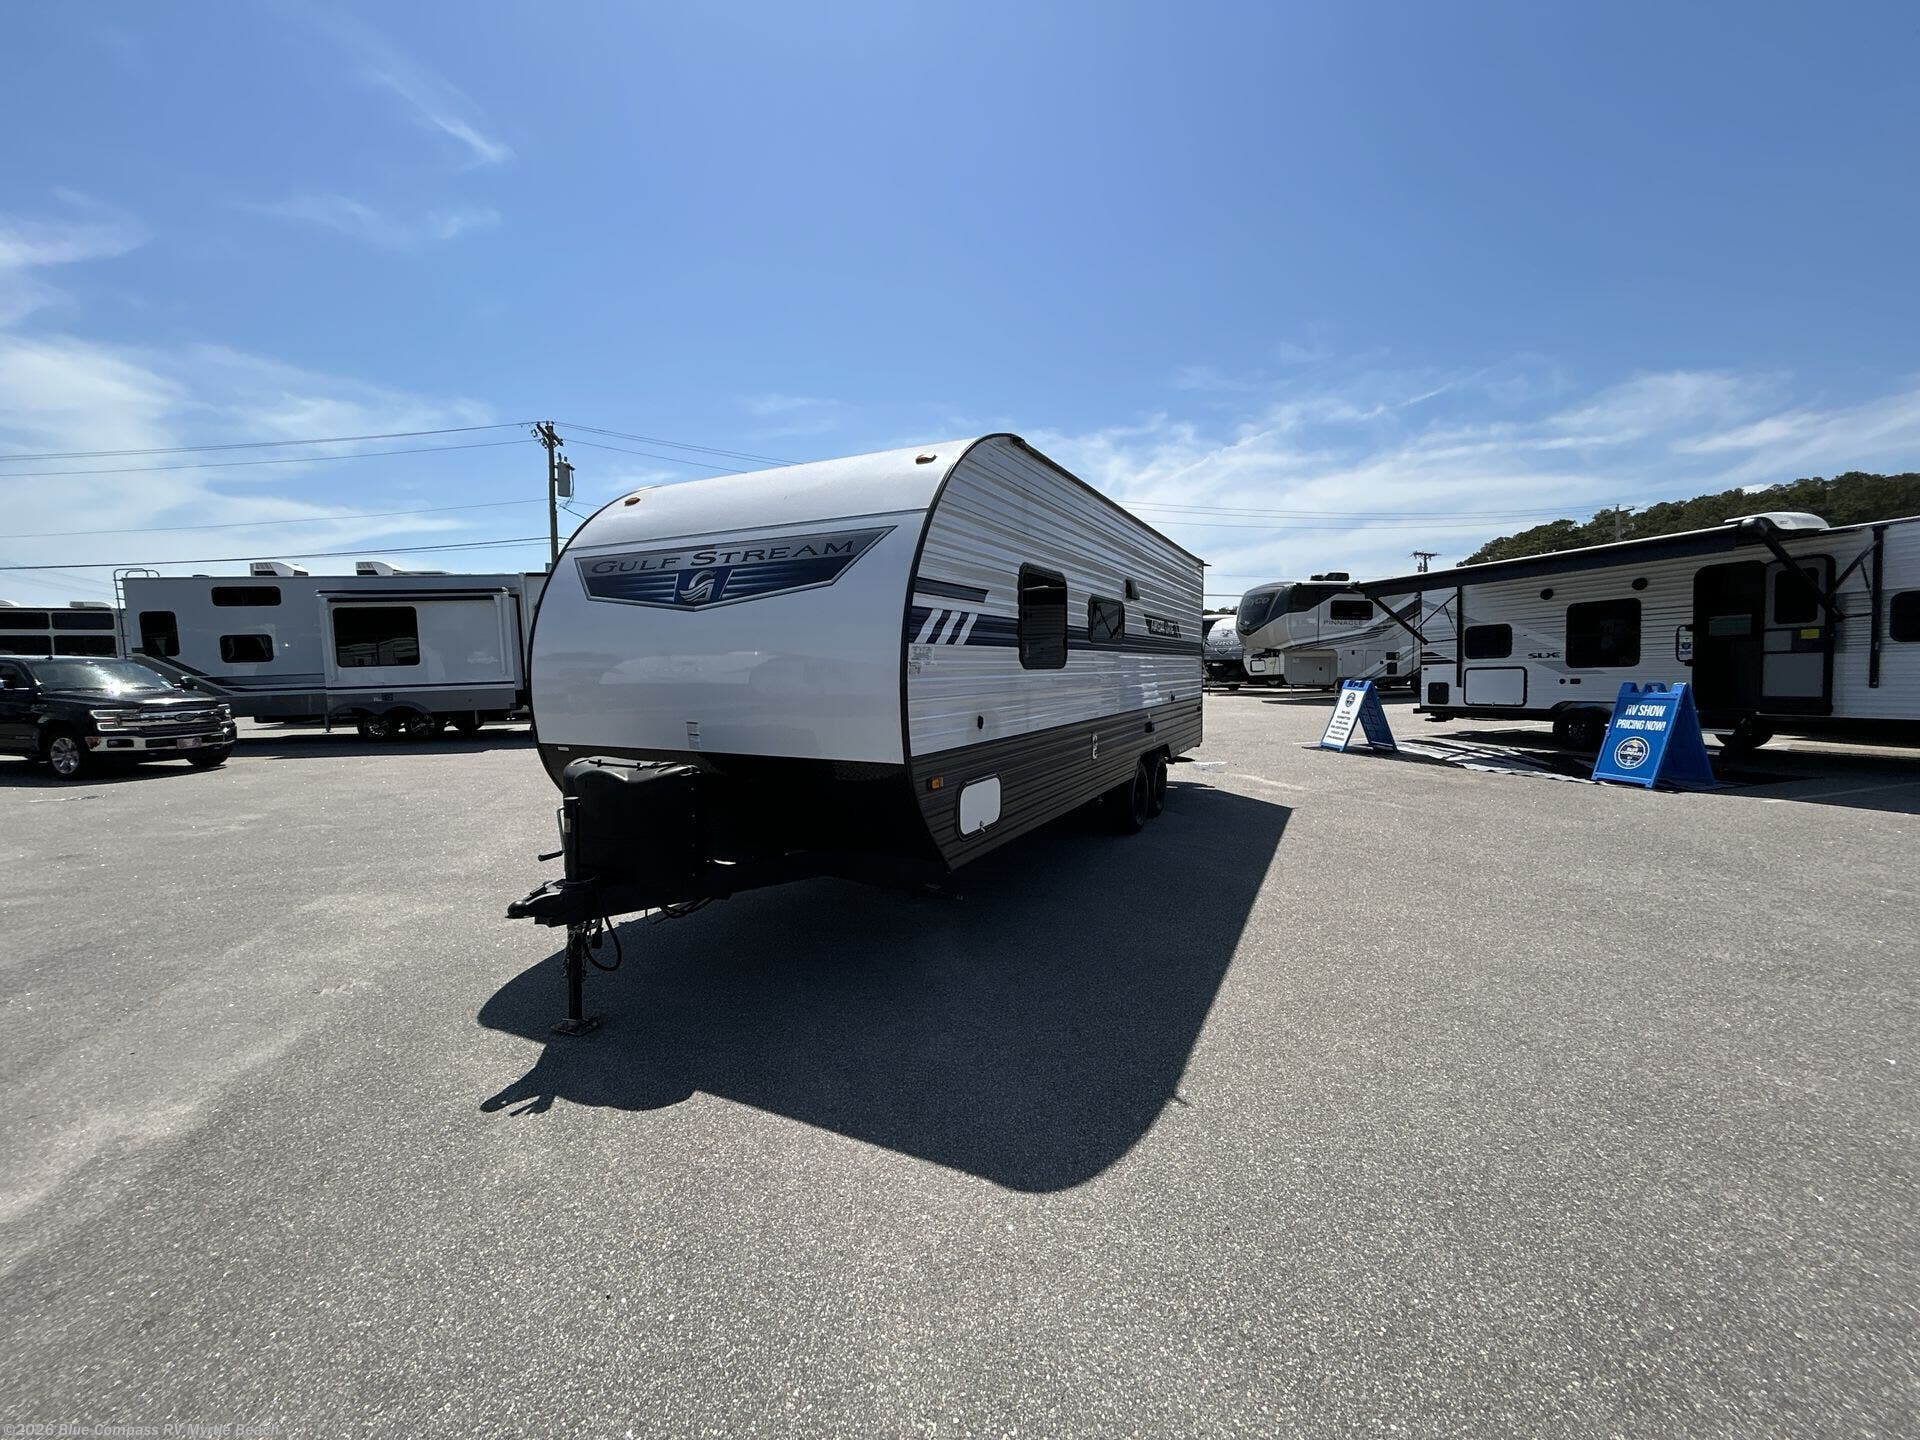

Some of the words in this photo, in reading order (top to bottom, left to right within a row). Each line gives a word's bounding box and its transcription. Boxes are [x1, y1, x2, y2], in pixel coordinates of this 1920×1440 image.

[591, 557, 681, 575] GULF
[690, 540, 855, 567] STREAM
[1625, 704, 1638, 716] RV
[1638, 705, 1666, 717] SHOW
[1616, 718, 1645, 731] PRICING
[1645, 720, 1666, 732] NOW!
